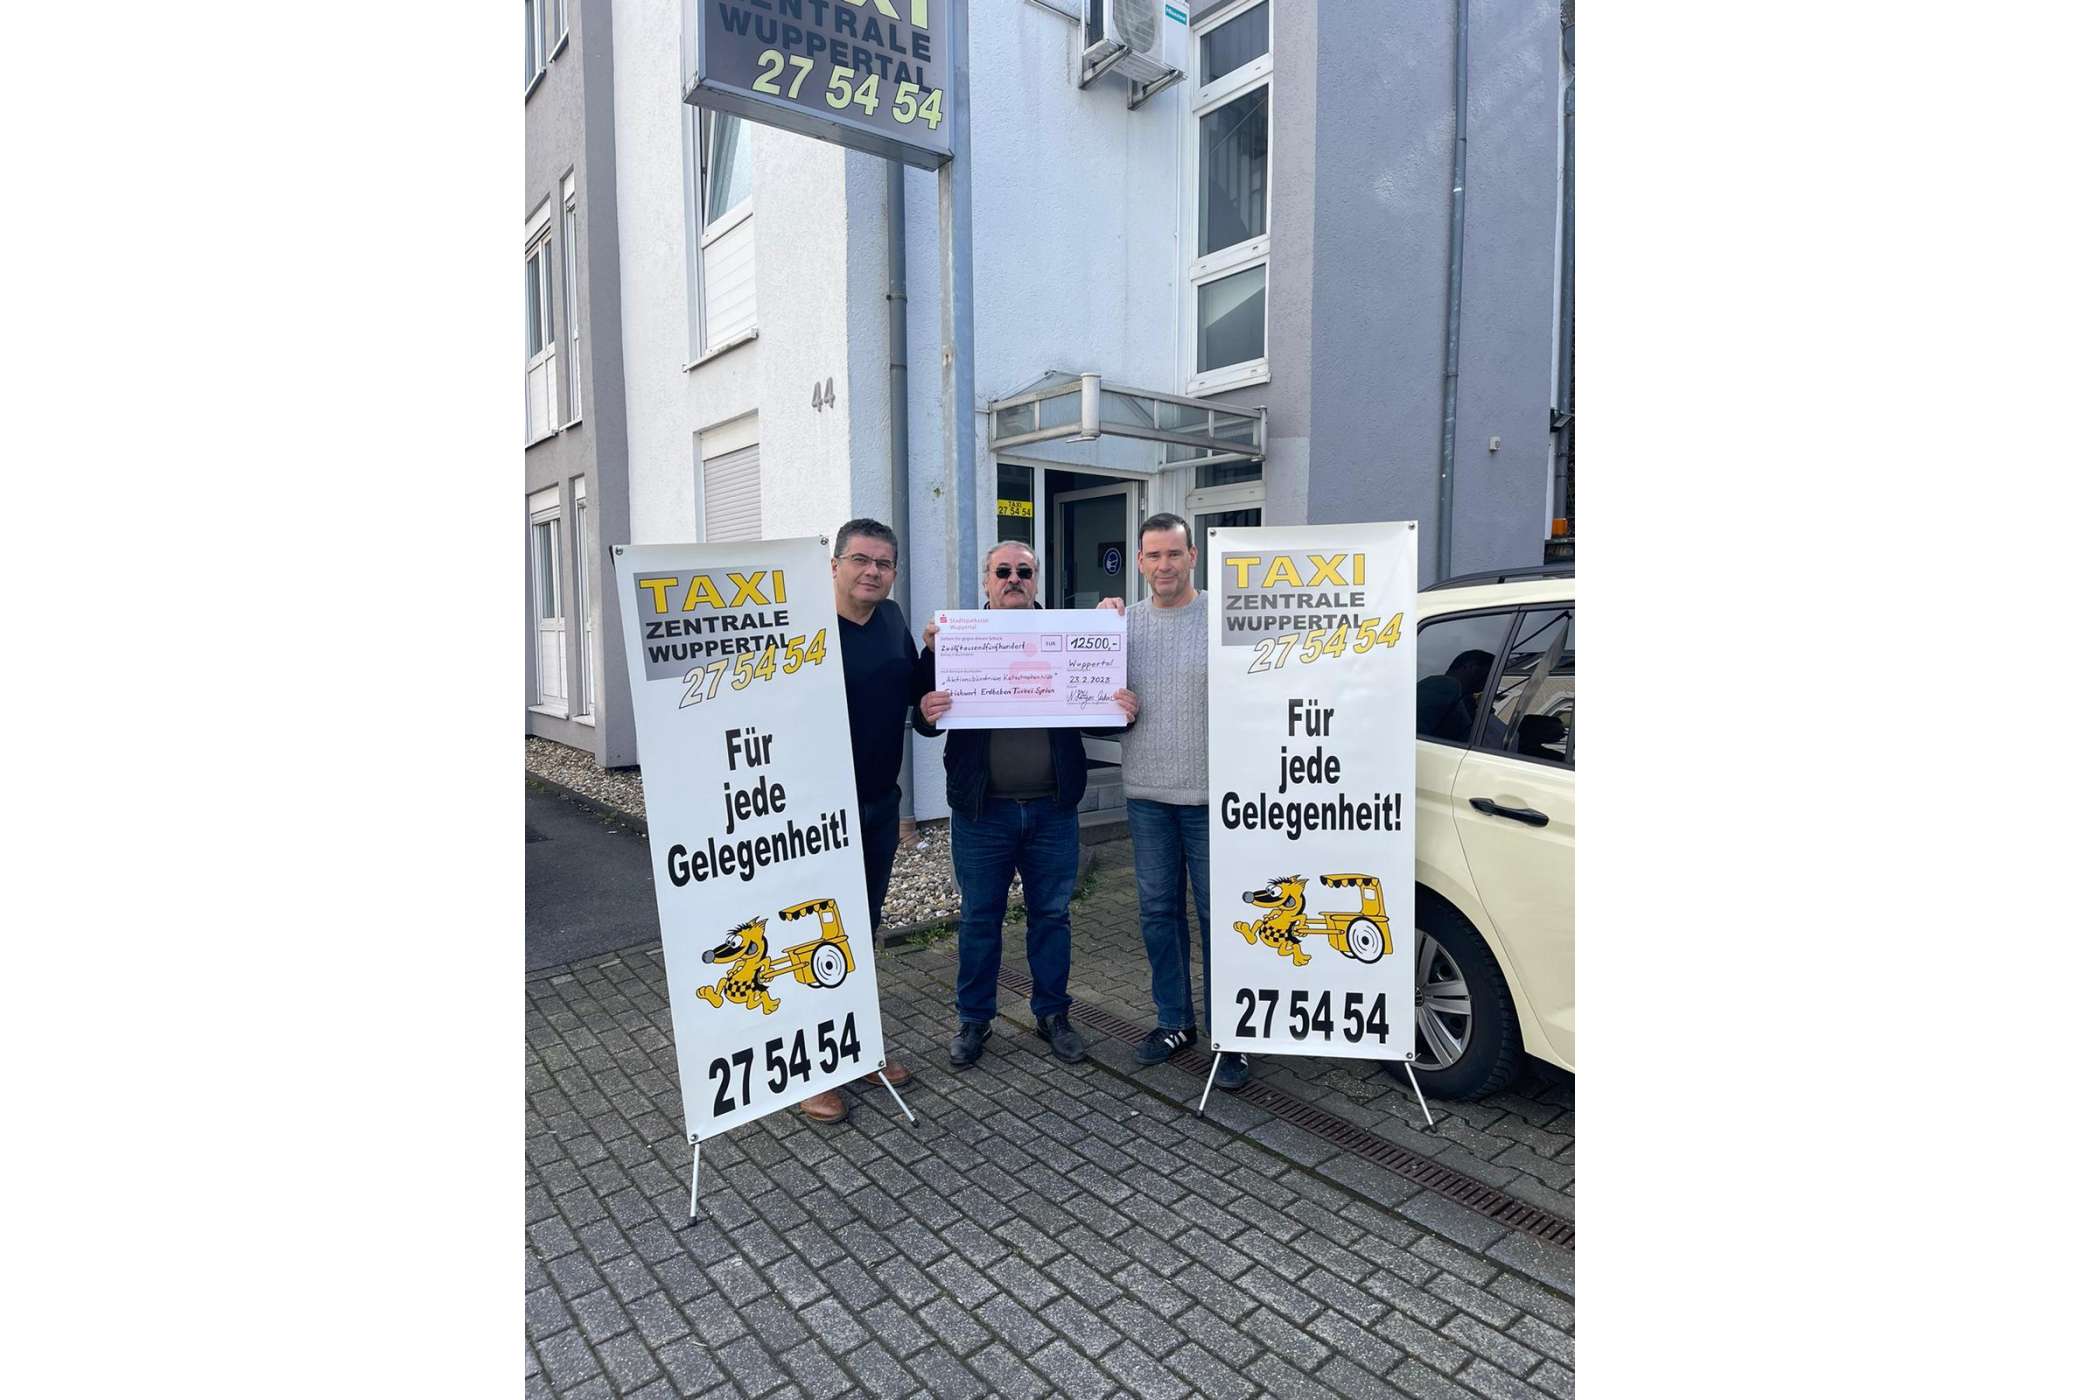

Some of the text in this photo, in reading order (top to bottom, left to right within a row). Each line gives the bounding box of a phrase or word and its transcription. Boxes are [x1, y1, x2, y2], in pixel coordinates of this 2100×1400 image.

[719, 3, 934, 93] WUPPERTAL
[752, 49, 943, 130] 27 54 54
[811, 377, 835, 412] 44
[998, 506, 1031, 516] 27 54 54
[639, 570, 787, 614] TAXI
[1225, 553, 1365, 588] TAXI
[1226, 592, 1365, 610] ZENTRALE
[1226, 614, 1364, 631] WUPPERTAL
[646, 610, 789, 639] ZENTRALE
[1248, 612, 1404, 674] 27 54 54
[648, 633, 791, 663] WUPPERTAL
[679, 629, 827, 709] 27 54 54
[1288, 699, 1334, 736] Für
[725, 727, 773, 771] Für
[1279, 746, 1340, 794] jede
[724, 776, 786, 834] jede
[1222, 792, 1401, 840] Gelegenheit!
[667, 809, 849, 887] Gelegenheit!
[1235, 988, 1389, 1044] 27 54 54
[709, 1012, 861, 1117] 27 54 54
